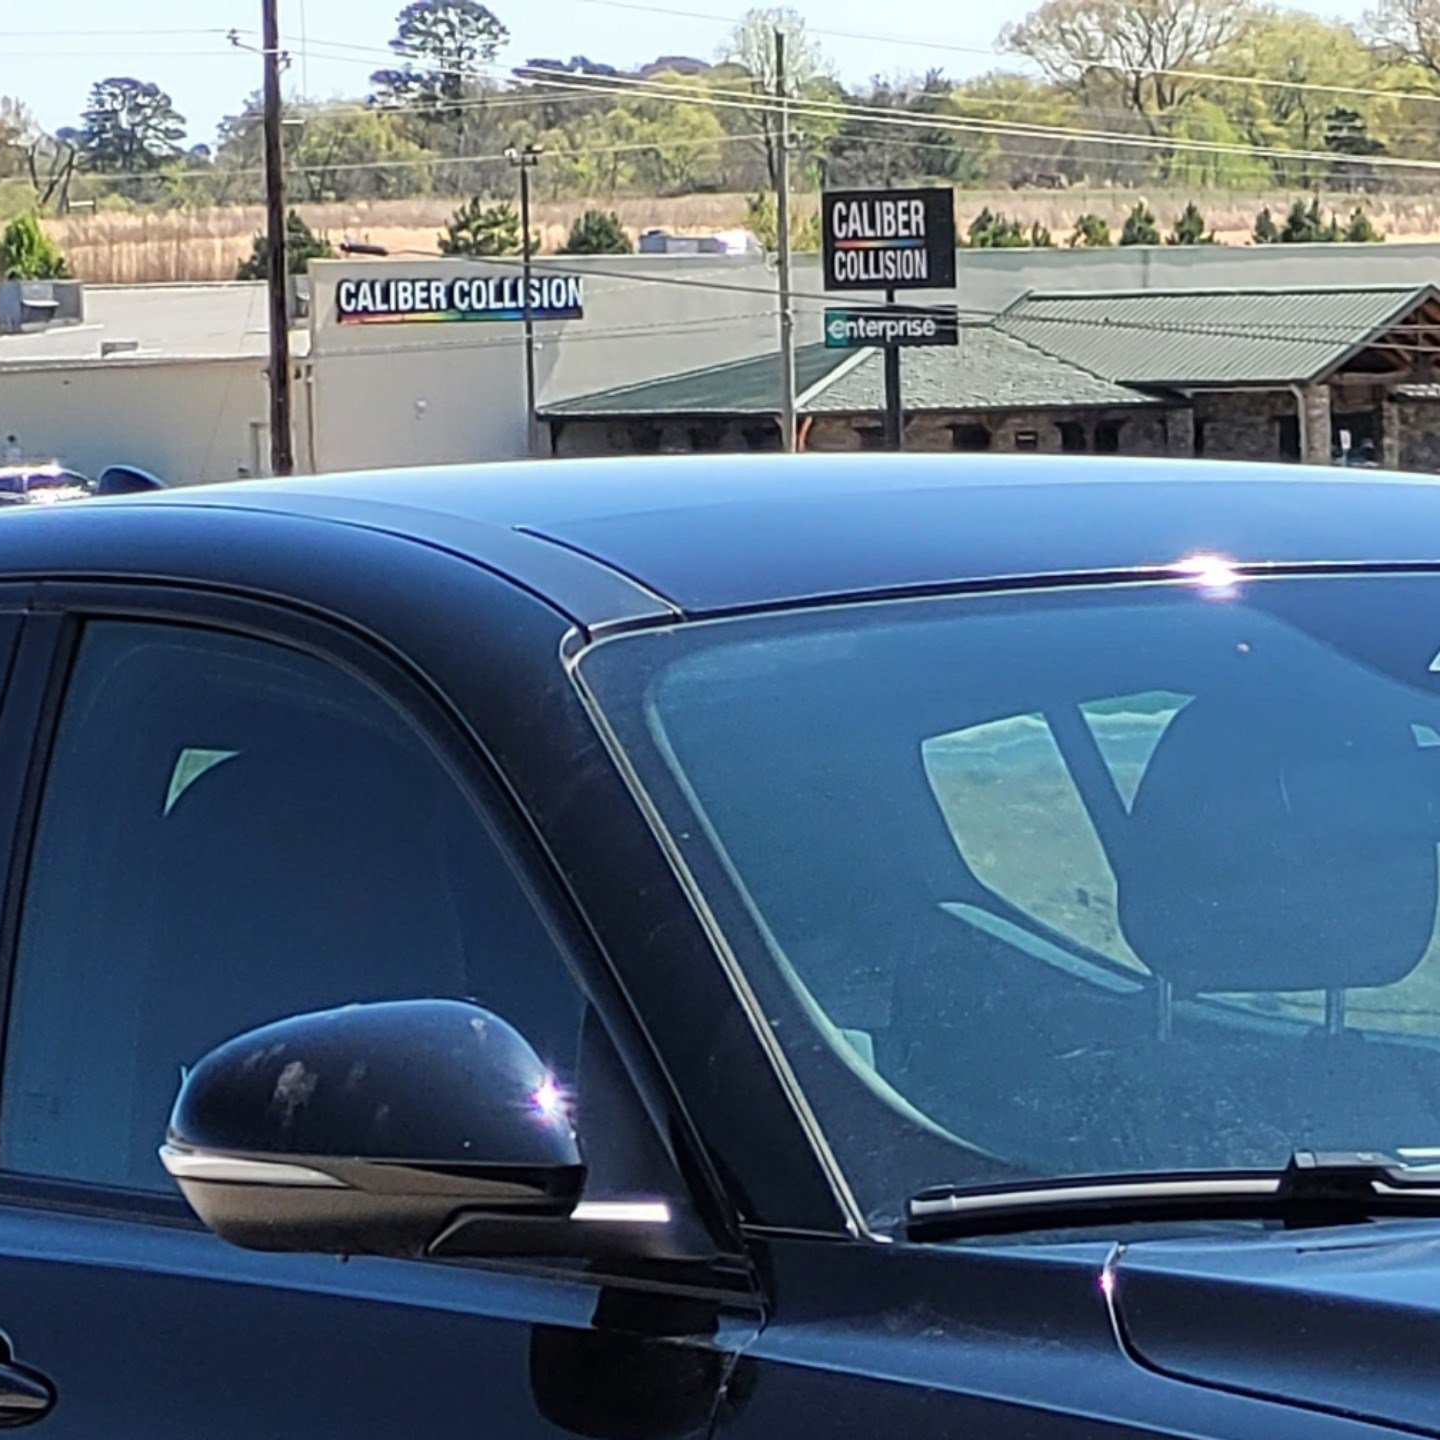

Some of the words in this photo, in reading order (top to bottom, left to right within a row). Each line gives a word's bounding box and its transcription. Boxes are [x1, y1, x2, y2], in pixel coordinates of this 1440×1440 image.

[832, 199, 926, 238] CALIBER
[833, 249, 929, 281] COLLISION
[339, 279, 447, 311] CALIBER
[453, 277, 584, 309] COLLISION
[827, 316, 937, 343] enterprise
